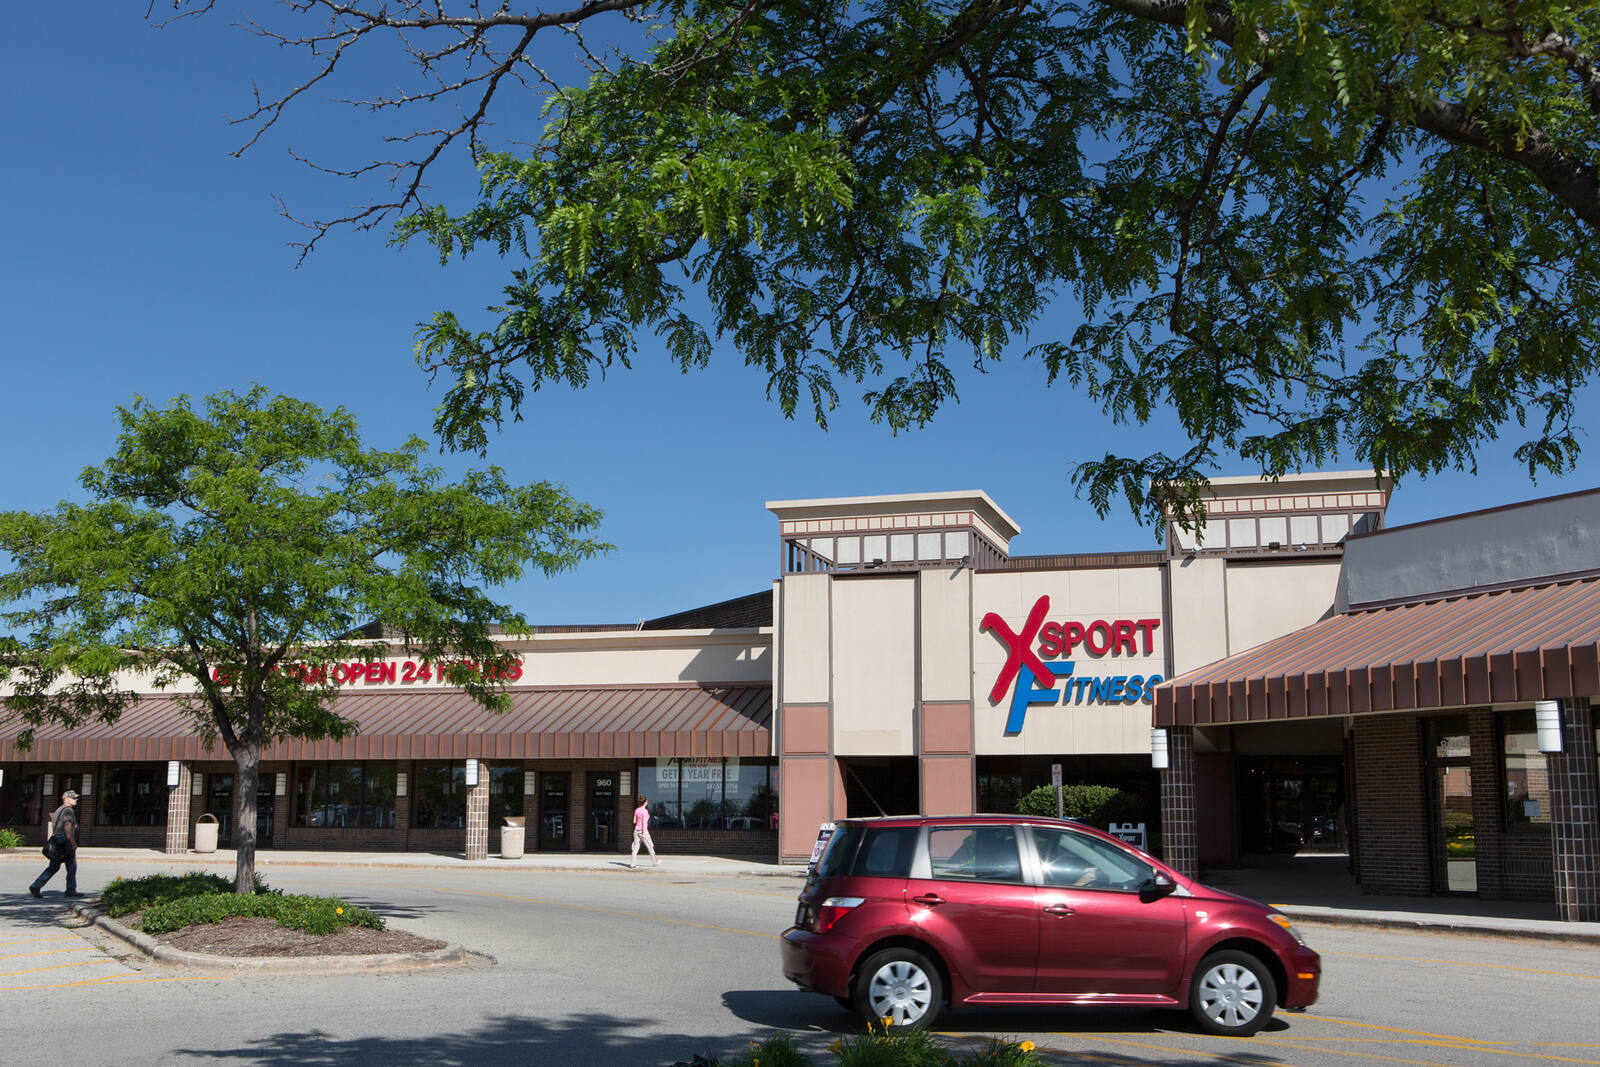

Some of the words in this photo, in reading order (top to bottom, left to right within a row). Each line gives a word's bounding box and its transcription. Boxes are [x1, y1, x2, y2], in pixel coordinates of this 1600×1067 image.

[332, 661, 397, 684] OPEN
[402, 660, 433, 682] 24
[662, 768, 678, 780] GET
[688, 768, 710, 780] YEAR
[711, 768, 736, 780] FRE
[596, 779, 612, 787] 960
